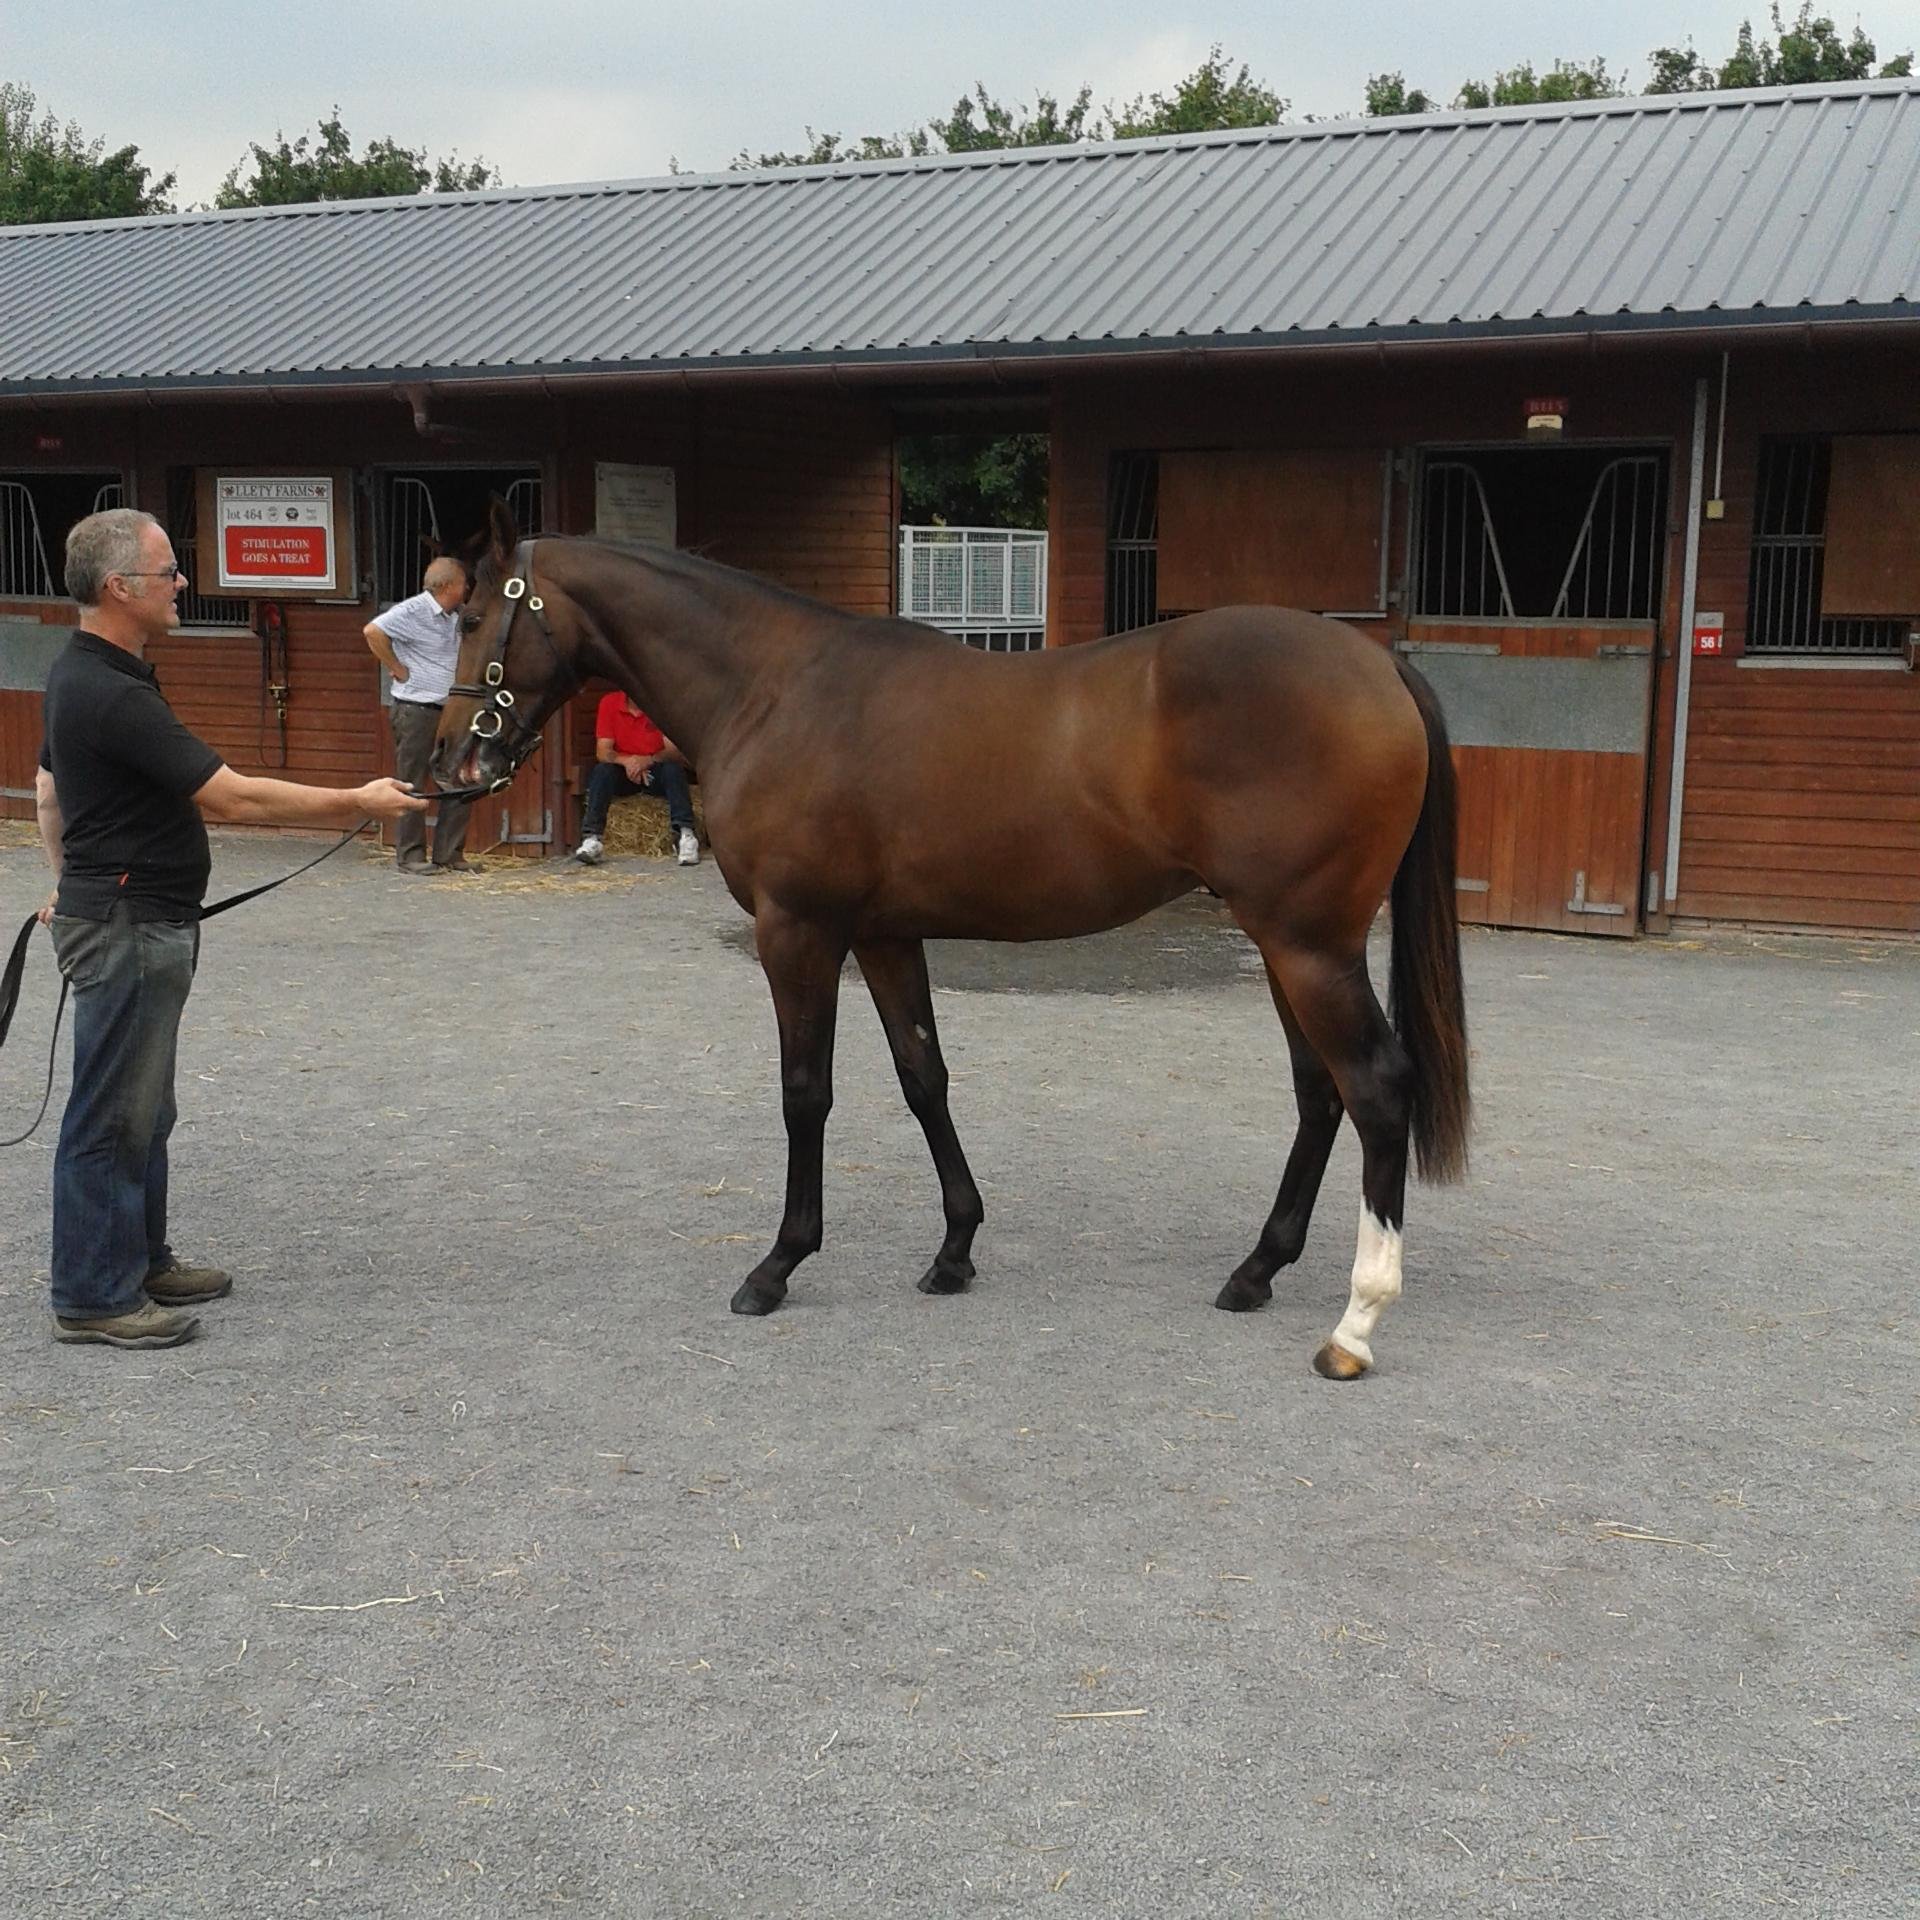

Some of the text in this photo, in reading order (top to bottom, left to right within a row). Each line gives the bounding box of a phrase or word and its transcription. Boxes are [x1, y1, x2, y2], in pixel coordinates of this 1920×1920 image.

[236, 485, 315, 497] LLETY FARMS
[244, 508, 262, 520] 464
[242, 539, 310, 549] STIMULATION
[242, 553, 311, 564] GOES A TREAT
[1700, 636, 1715, 648] 56
